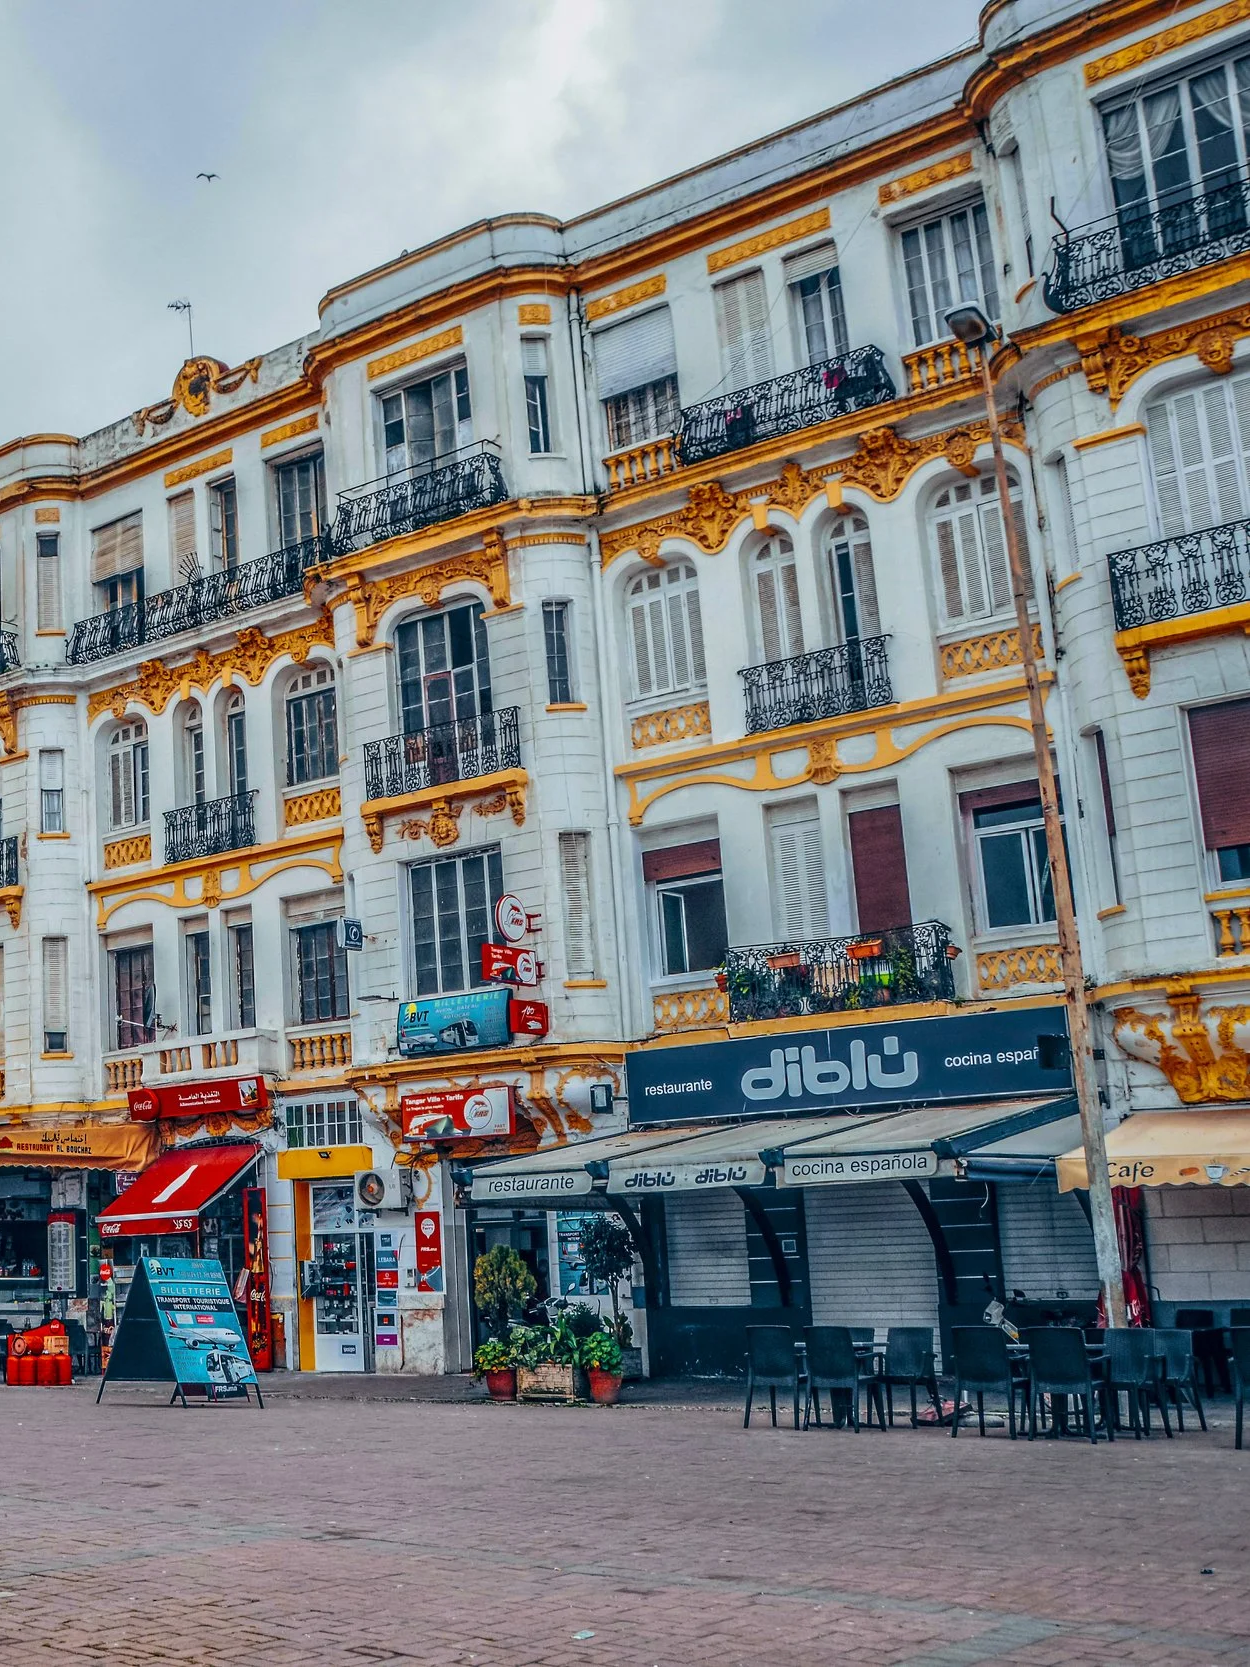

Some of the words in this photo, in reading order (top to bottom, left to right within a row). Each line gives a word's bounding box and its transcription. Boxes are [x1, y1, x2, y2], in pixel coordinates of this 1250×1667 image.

[410, 1011, 429, 1022] BVT
[944, 1053, 991, 1068] cocina
[644, 1078, 712, 1096] restaurante
[17, 1143, 54, 1151] RESTAURANT
[792, 1159, 844, 1176] cocina
[850, 1155, 927, 1175] española
[488, 1175, 574, 1193] restaurante
[156, 1267, 175, 1277] BVT
[160, 1286, 221, 1296] BILLETTERIE
[156, 1296, 191, 1304] TRANSPORT
[192, 1297, 230, 1305] TOURISTIQUE
